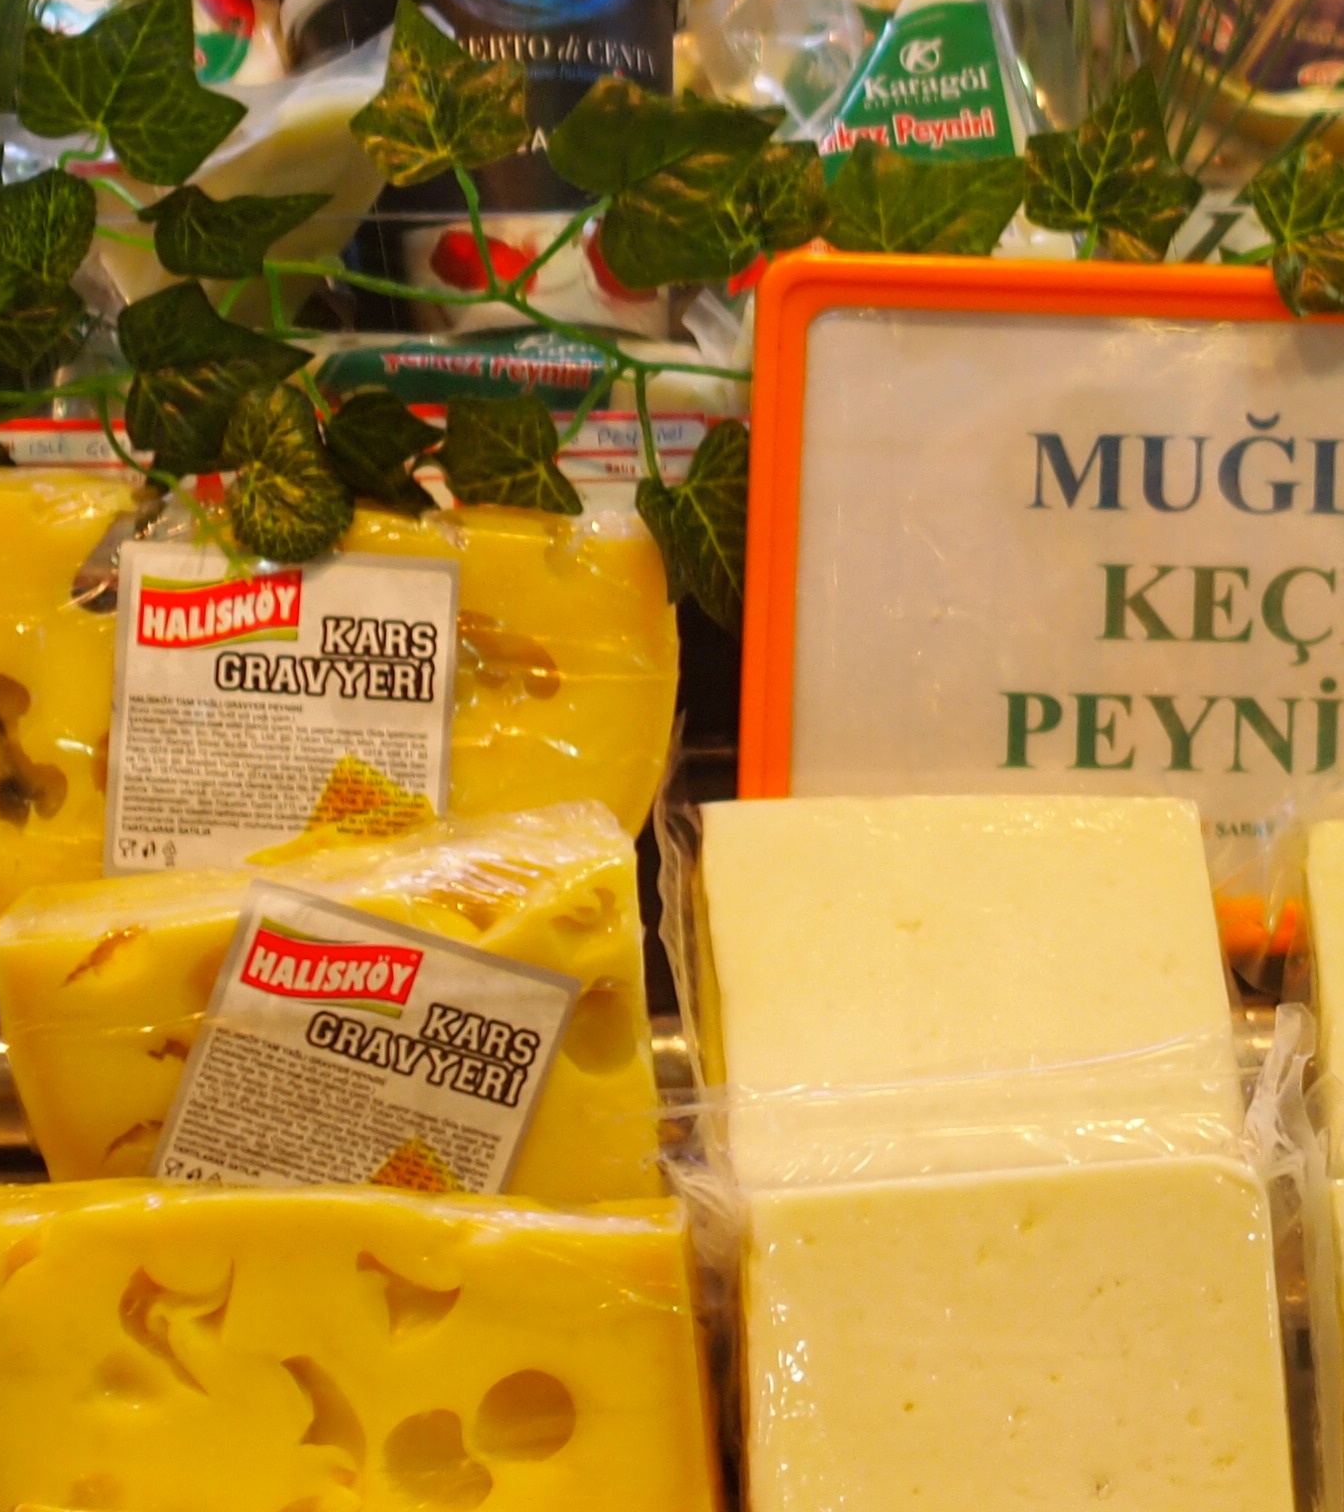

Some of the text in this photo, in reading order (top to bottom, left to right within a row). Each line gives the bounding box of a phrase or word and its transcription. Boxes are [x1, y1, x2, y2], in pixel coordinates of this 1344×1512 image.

[864, 65, 989, 101] Karagöl
[892, 105, 996, 149] Peyniri
[142, 581, 297, 643] HALİSKÖY
[321, 616, 438, 660] KARS
[215, 651, 436, 702] GRAVYERİ
[247, 945, 415, 997] HALİSKÖY
[306, 1011, 529, 1108] GRAVYERİ
[421, 1002, 540, 1069] KARS
